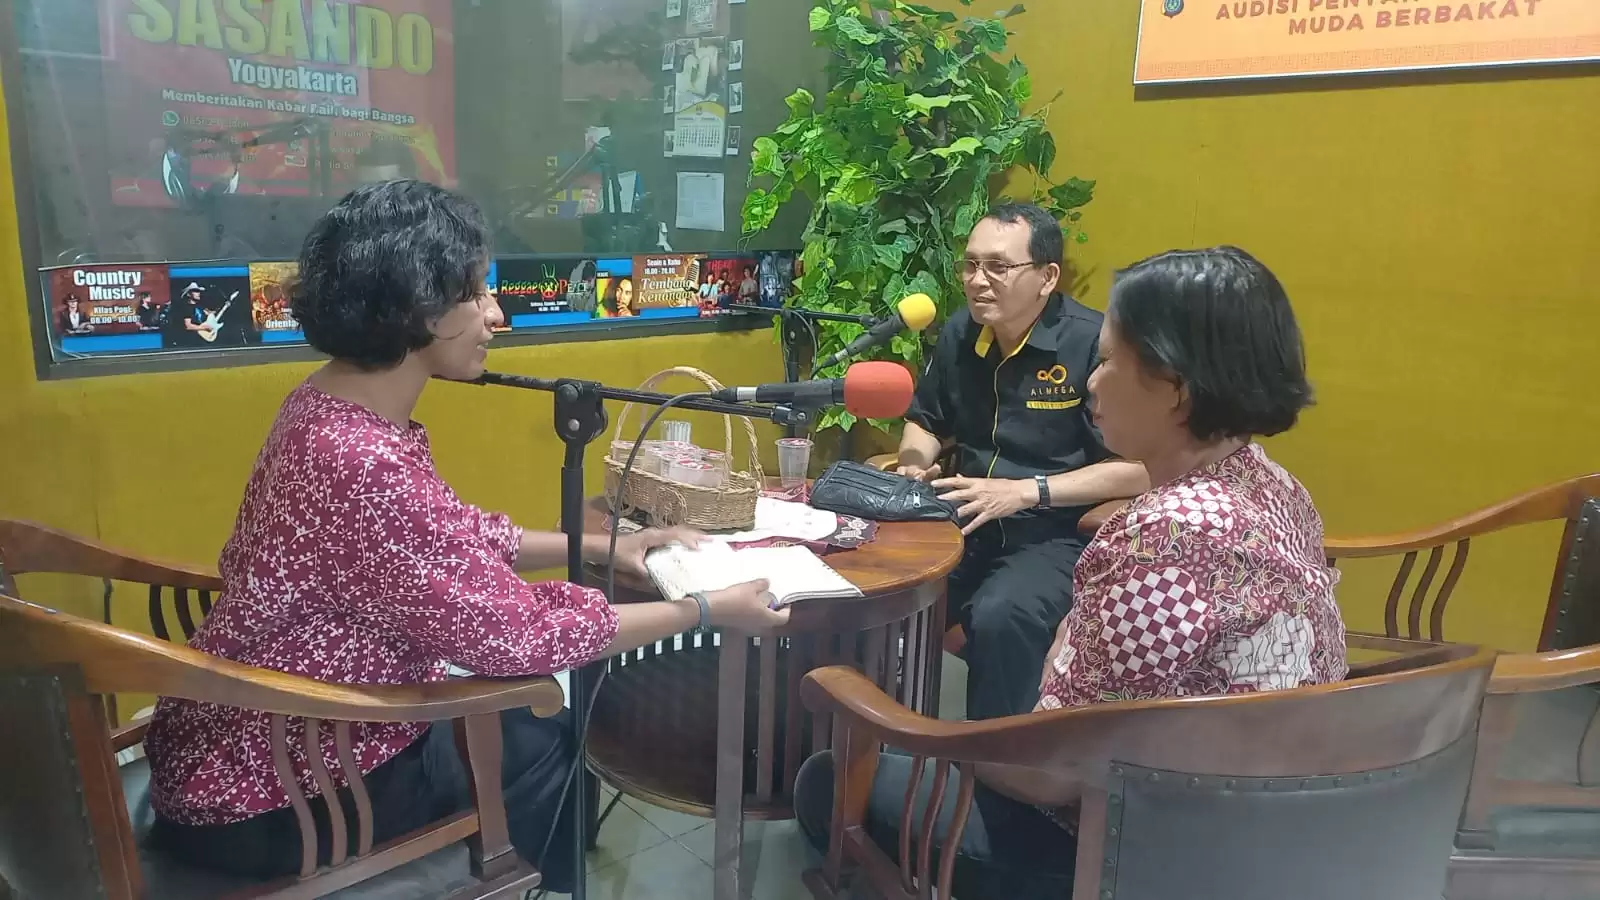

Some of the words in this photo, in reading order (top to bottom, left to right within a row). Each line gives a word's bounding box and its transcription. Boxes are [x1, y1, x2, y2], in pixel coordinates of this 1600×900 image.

[1216, 0, 1298, 20] AUDISI
[1288, 13, 1364, 36] MUDA
[1375, 0, 1541, 28] BERBAKAT
[127, 0, 435, 75] SASANDO
[228, 58, 358, 96] Yogyakarta
[163, 88, 263, 108] Memberitakan
[267, 99, 307, 114] Kabar
[372, 109, 415, 125] Bangsa
[73, 269, 142, 286] Country
[640, 277, 692, 291] Tembang
[89, 285, 135, 301] Music
[501, 280, 538, 295] Reggae
[638, 290, 694, 304] Kenangan
